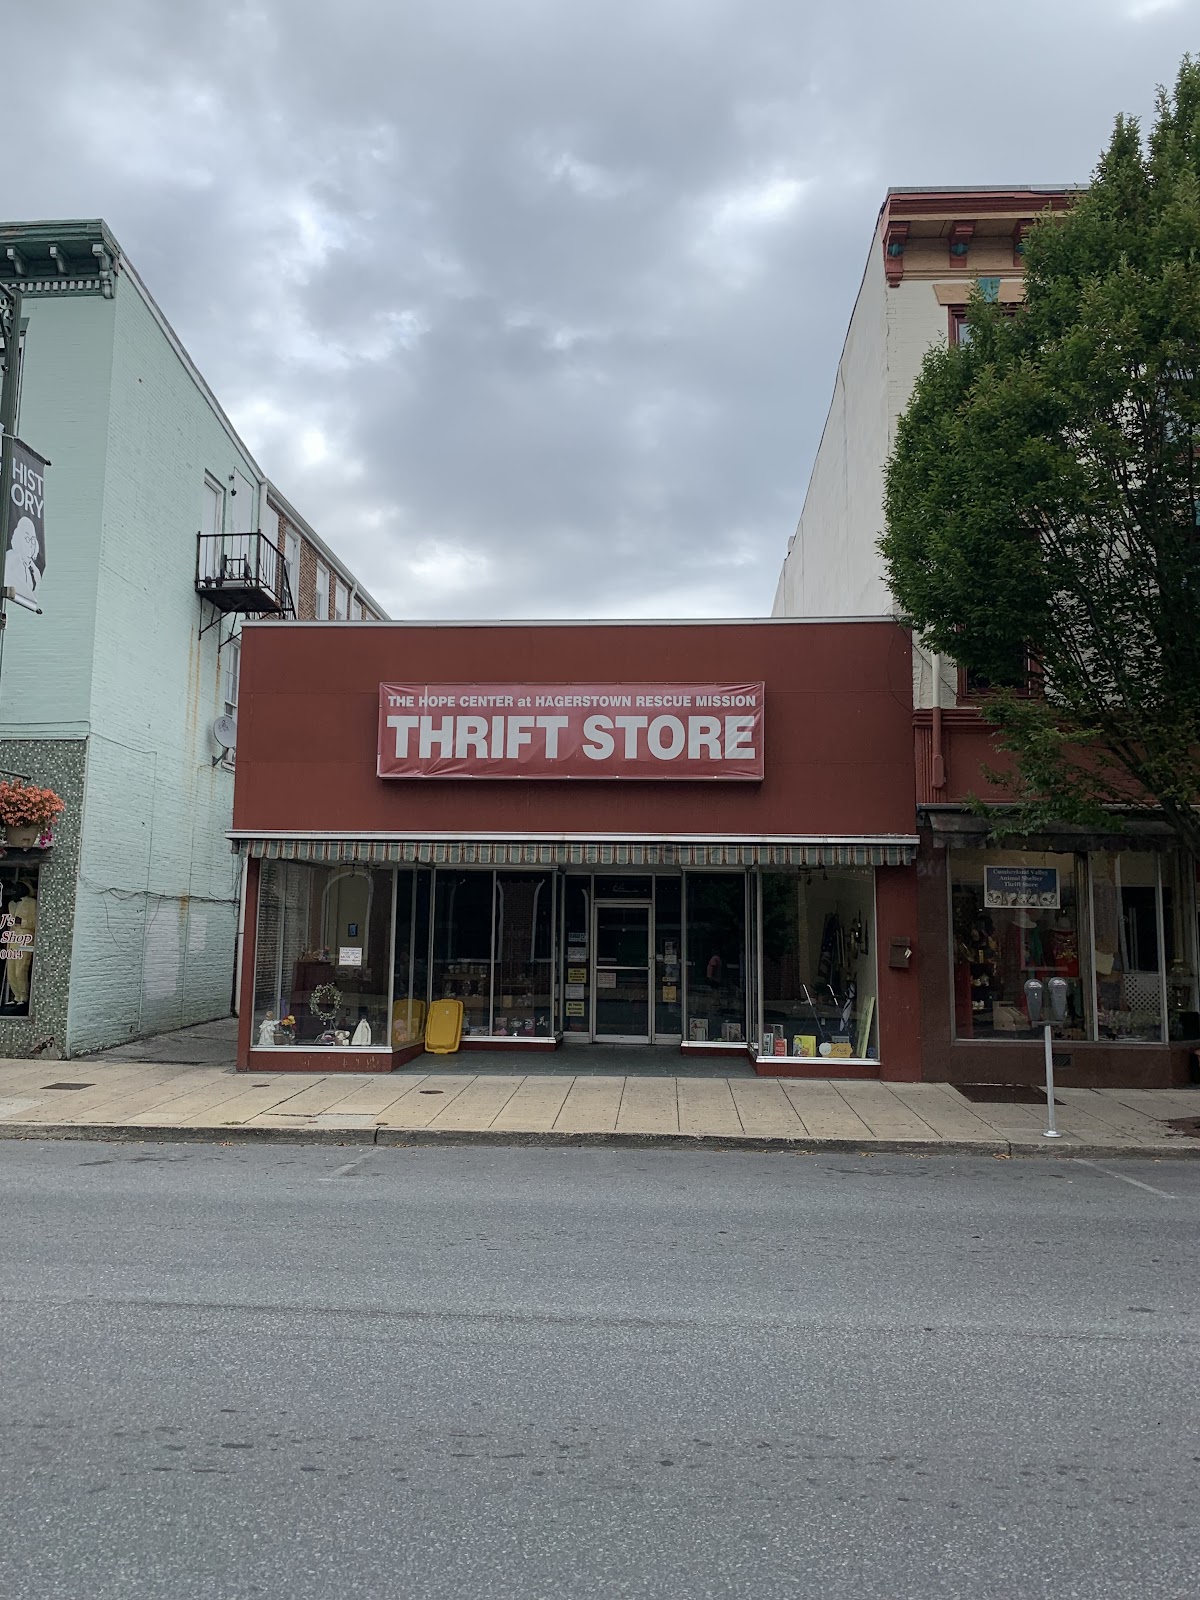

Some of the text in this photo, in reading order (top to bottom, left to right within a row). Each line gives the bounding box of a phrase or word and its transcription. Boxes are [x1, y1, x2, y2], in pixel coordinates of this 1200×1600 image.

[12, 457, 44, 497] HIST
[11, 483, 44, 519] ORY
[387, 695, 756, 708] THE HOPE CENTER at HAGERSTOWN RESCUE MISSION
[386, 714, 756, 760] THRIFT STORE
[0, 930, 33, 946] Shop
